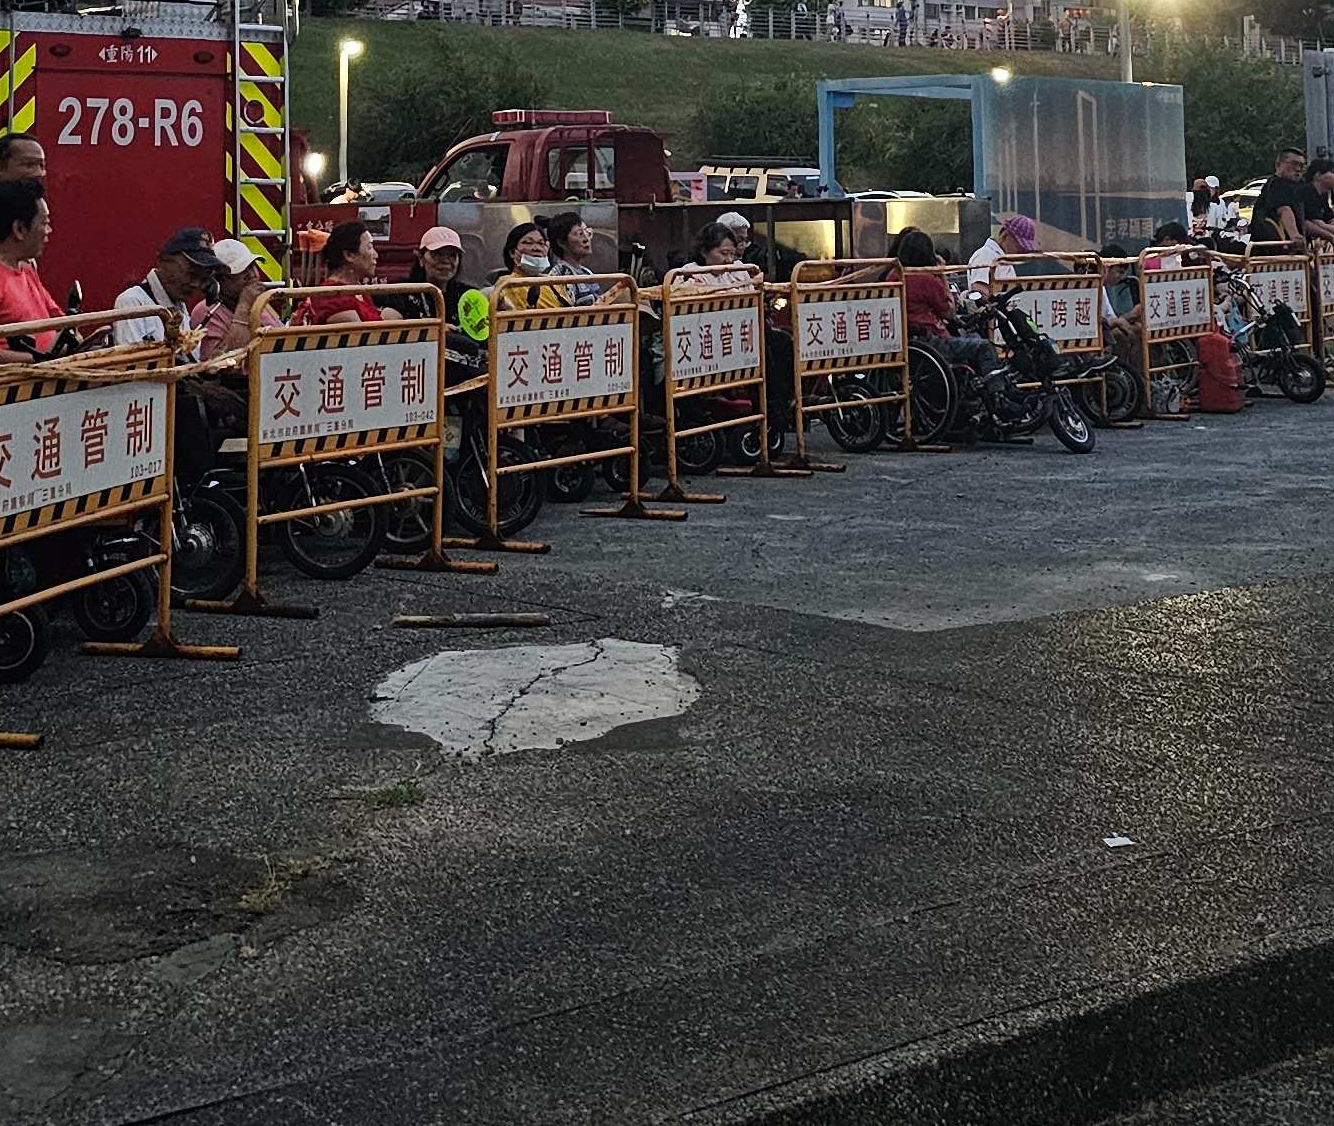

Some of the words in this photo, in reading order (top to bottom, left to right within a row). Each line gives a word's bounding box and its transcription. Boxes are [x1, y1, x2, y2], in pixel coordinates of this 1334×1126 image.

[58, 97, 204, 147] 278-R6
[1149, 285, 1206, 320] 交通管制
[676, 319, 754, 364] 交通管制
[806, 308, 895, 346] 交通管制
[507, 337, 624, 388] 交通管制
[273, 358, 426, 421] 交通管制
